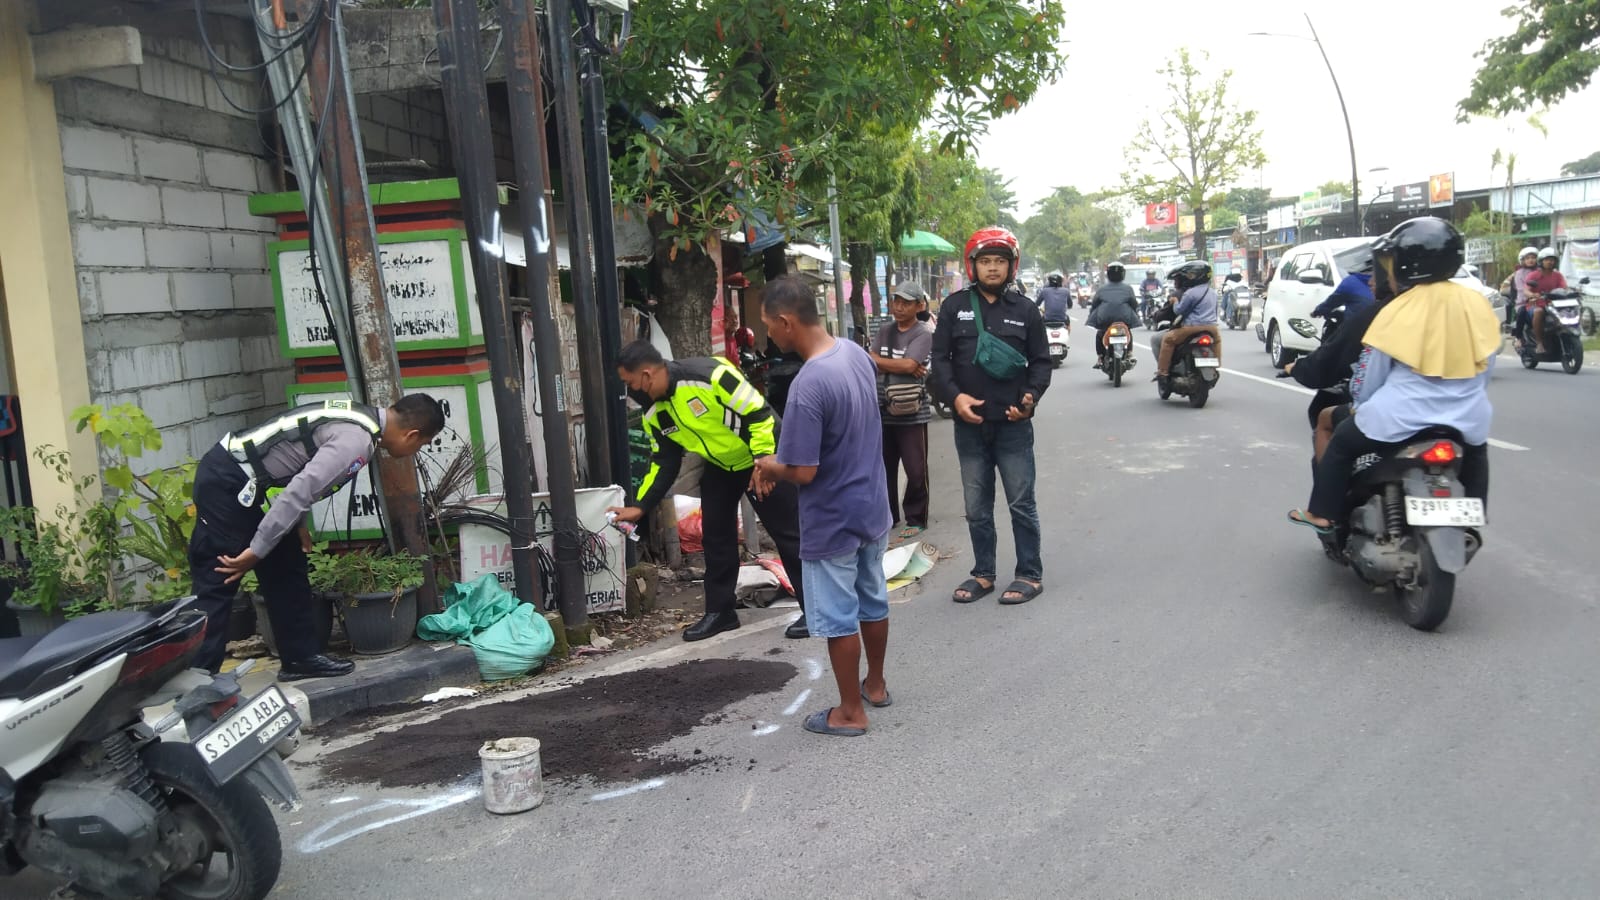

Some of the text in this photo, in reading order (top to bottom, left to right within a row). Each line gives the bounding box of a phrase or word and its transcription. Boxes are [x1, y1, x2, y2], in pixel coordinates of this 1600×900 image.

[205, 696, 280, 759] S 3123 ABA
